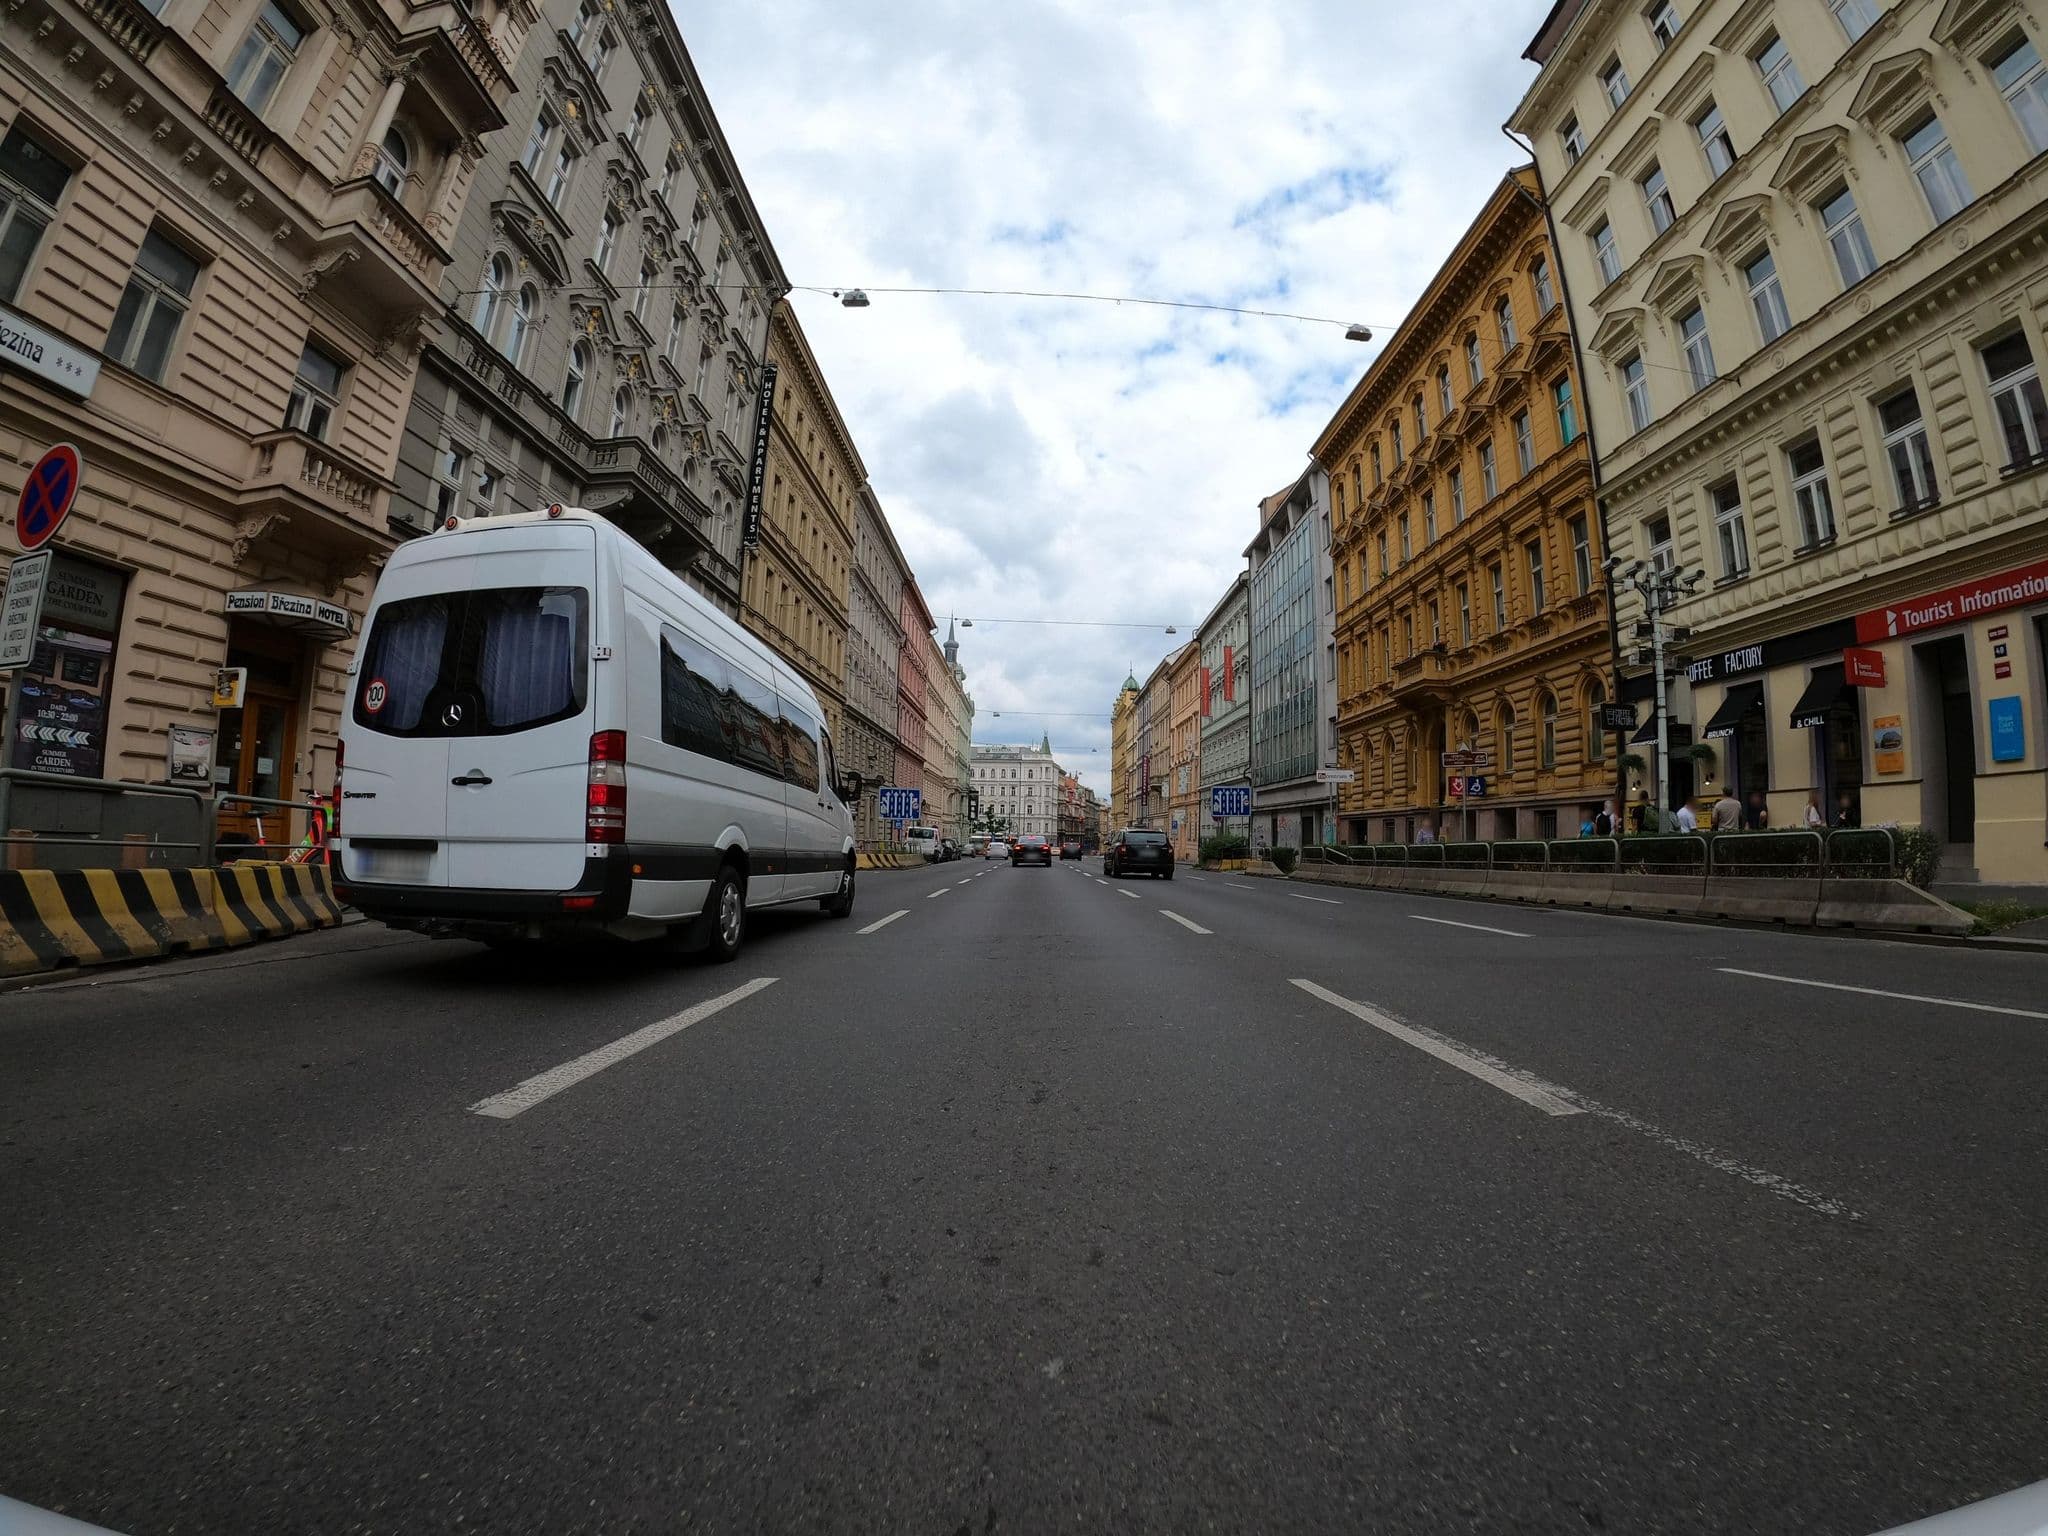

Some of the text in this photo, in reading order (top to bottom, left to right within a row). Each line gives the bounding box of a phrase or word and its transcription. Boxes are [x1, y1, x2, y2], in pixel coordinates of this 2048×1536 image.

[749, 381, 773, 533] HOTEL & APARTMENTS
[57, 569, 97, 590] SUMMER
[47, 580, 104, 607] GARDEN
[228, 594, 345, 625] Pension Březina HOTEL
[1902, 600, 1955, 628] Tourist
[1725, 645, 1764, 674] FACTORY
[368, 686, 384, 702] 100
[50, 703, 68, 712] DAILY
[37, 709, 56, 720] 10:30
[60, 712, 79, 723] 22:00
[1796, 715, 1825, 728] & CHILL
[1707, 727, 1734, 739] BRUNCH
[42, 749, 67, 758] SUMMER
[35, 756, 71, 768] GARDEN
